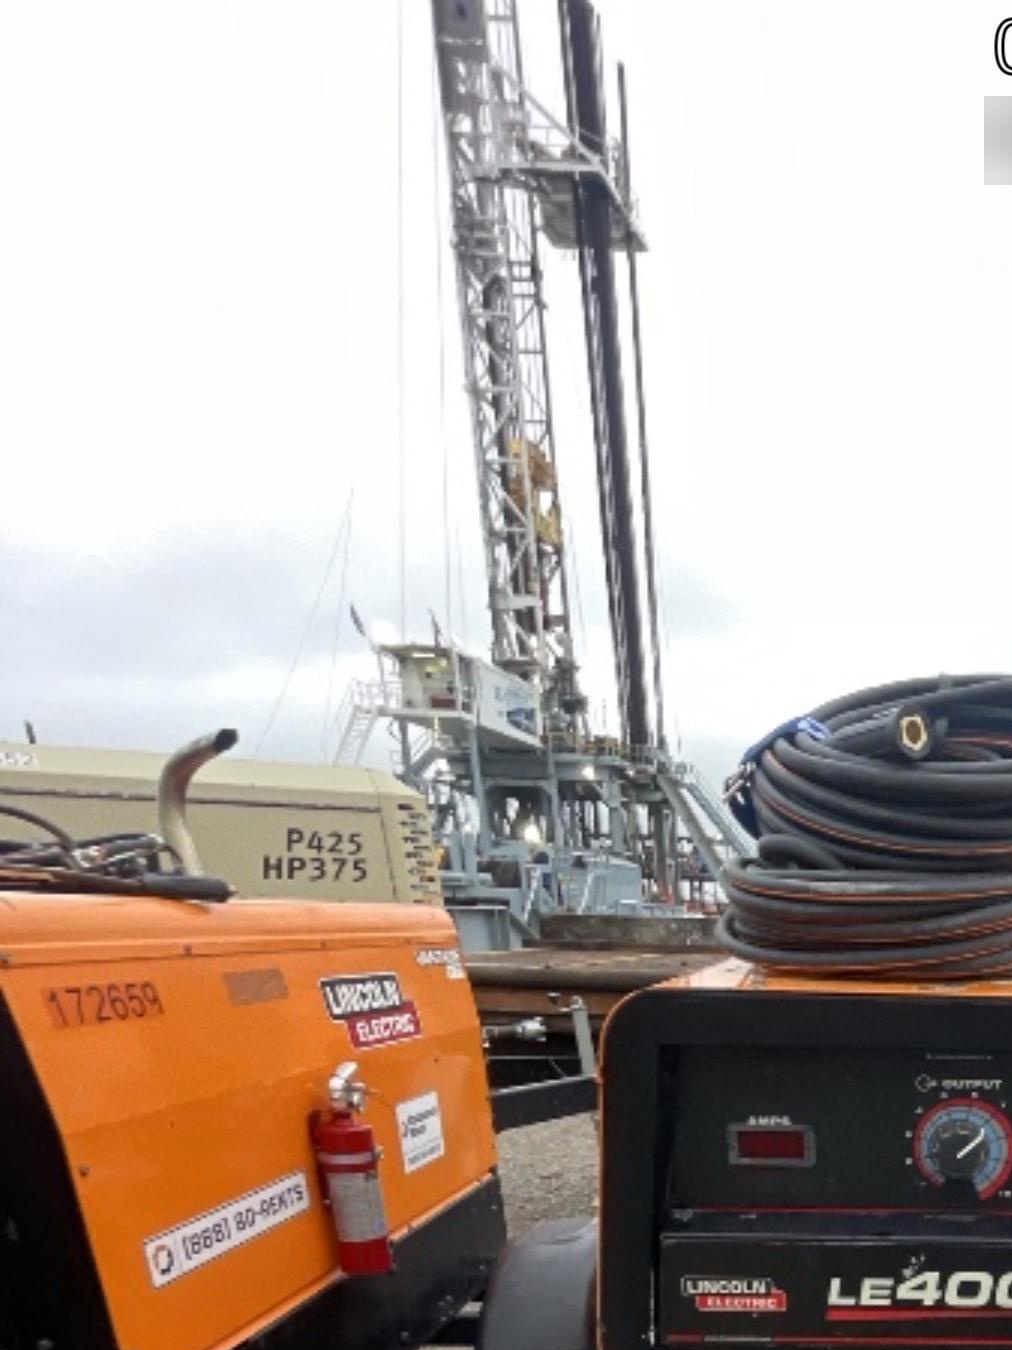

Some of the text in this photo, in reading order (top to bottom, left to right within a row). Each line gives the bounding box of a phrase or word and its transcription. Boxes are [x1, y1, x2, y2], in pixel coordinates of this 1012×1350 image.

[286, 826, 364, 856] P425
[262, 854, 368, 883] HP375
[47, 981, 165, 1027] 172659
[325, 979, 401, 1016] LINCOLN
[355, 1012, 416, 1043] ELECTRIC
[941, 1079, 1002, 1090] OUTPUT
[686, 1279, 767, 1295] LINCOLN
[706, 1296, 778, 1309] ELECTRIC
